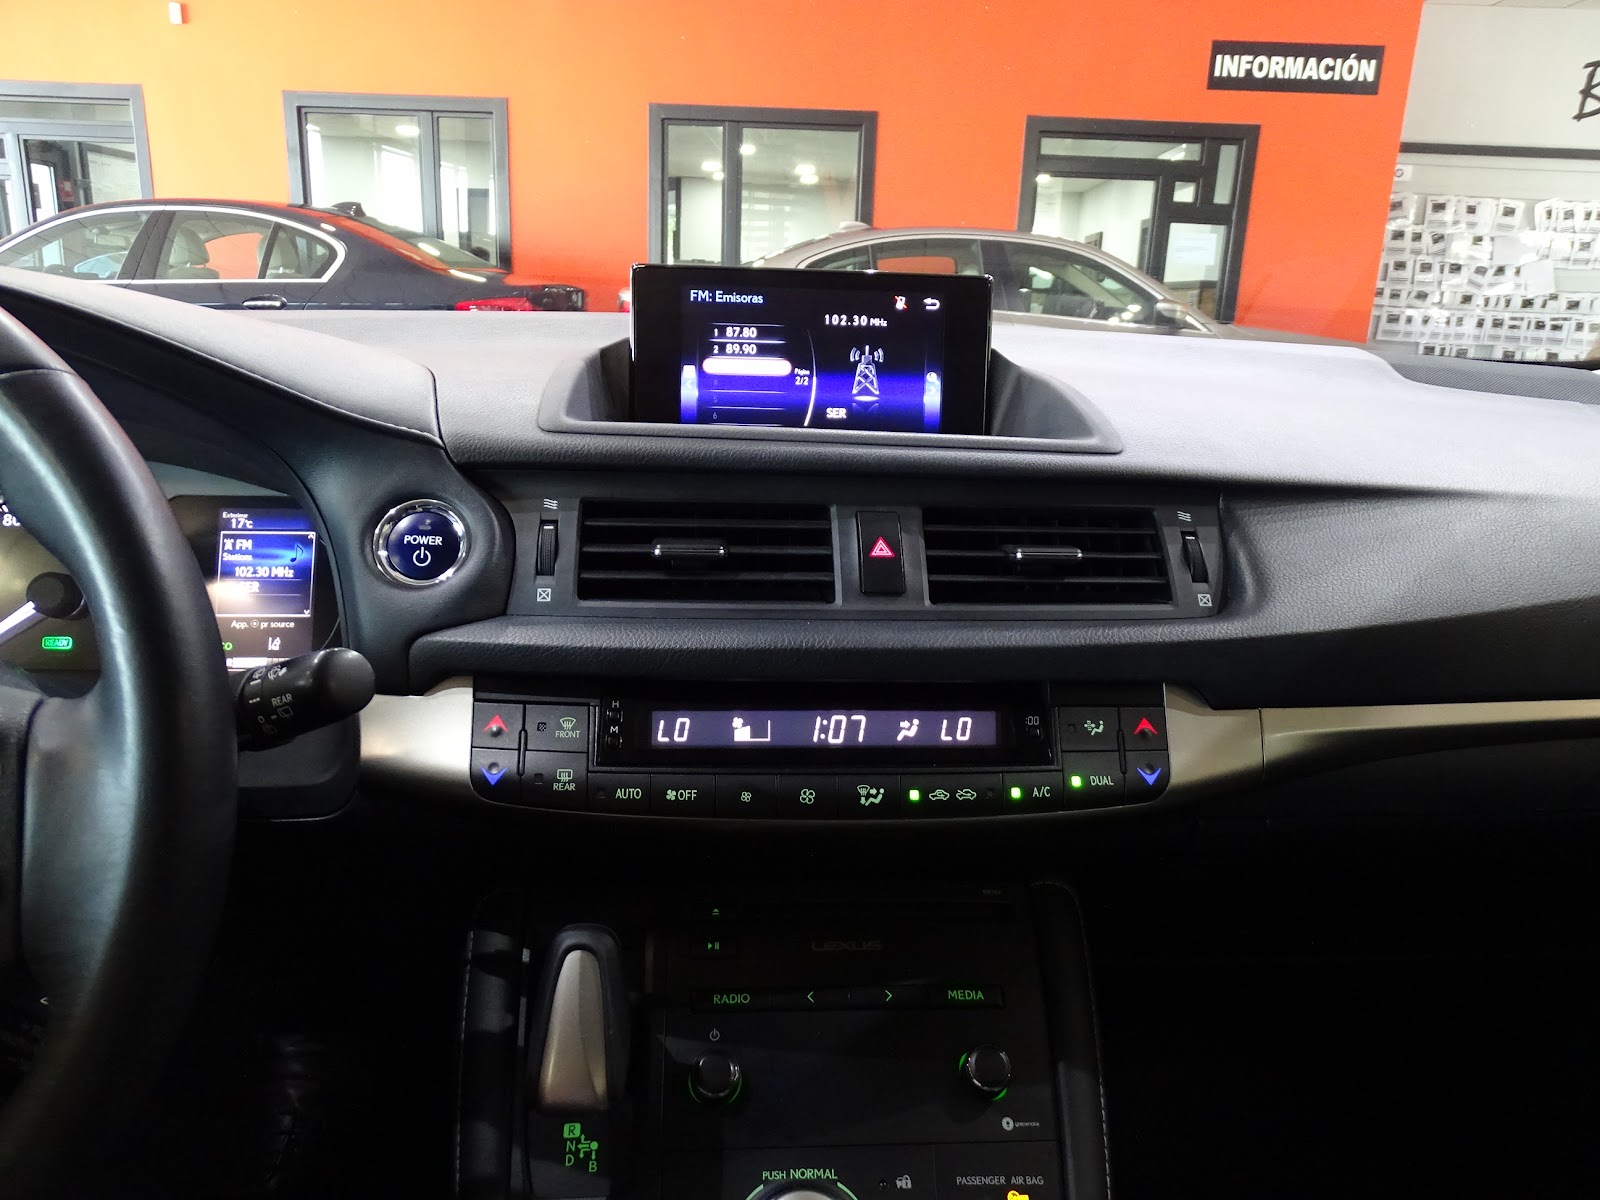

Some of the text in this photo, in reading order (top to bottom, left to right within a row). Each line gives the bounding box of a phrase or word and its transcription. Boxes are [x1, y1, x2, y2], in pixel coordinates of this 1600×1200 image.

[1213, 54, 1377, 82] INFORMACIÓN
[690, 289, 764, 304] FM: Emisoras
[824, 313, 888, 327] 102.30 MHz
[726, 326, 757, 338] 87.80
[713, 343, 757, 355] 2 89.90
[795, 376, 809, 385] 2/2
[712, 411, 718, 420] 6
[825, 407, 847, 419] SER
[235, 539, 253, 550] FM
[403, 535, 443, 546] POWER
[235, 566, 294, 578] 102.30 MHz
[230, 619, 249, 629] App.
[271, 693, 293, 707] REAR
[611, 700, 620, 708] H
[555, 730, 581, 739] FRONT
[610, 725, 619, 734] M
[813, 715, 867, 744] 1:07
[553, 780, 576, 791] REAR
[1089, 775, 1114, 787] DUAL
[615, 788, 642, 800] AUTO
[677, 789, 698, 801] OFF
[1032, 786, 1051, 798] A/C
[713, 993, 750, 1005] RADIO
[947, 989, 984, 1001] MEDIA
[566, 1140, 576, 1152] N
[565, 1154, 575, 1167] D
[588, 1160, 598, 1173] B
[762, 1168, 838, 1181] PUSH NORMAL
[956, 1175, 1044, 1186] PASSENGER AIR BAG
